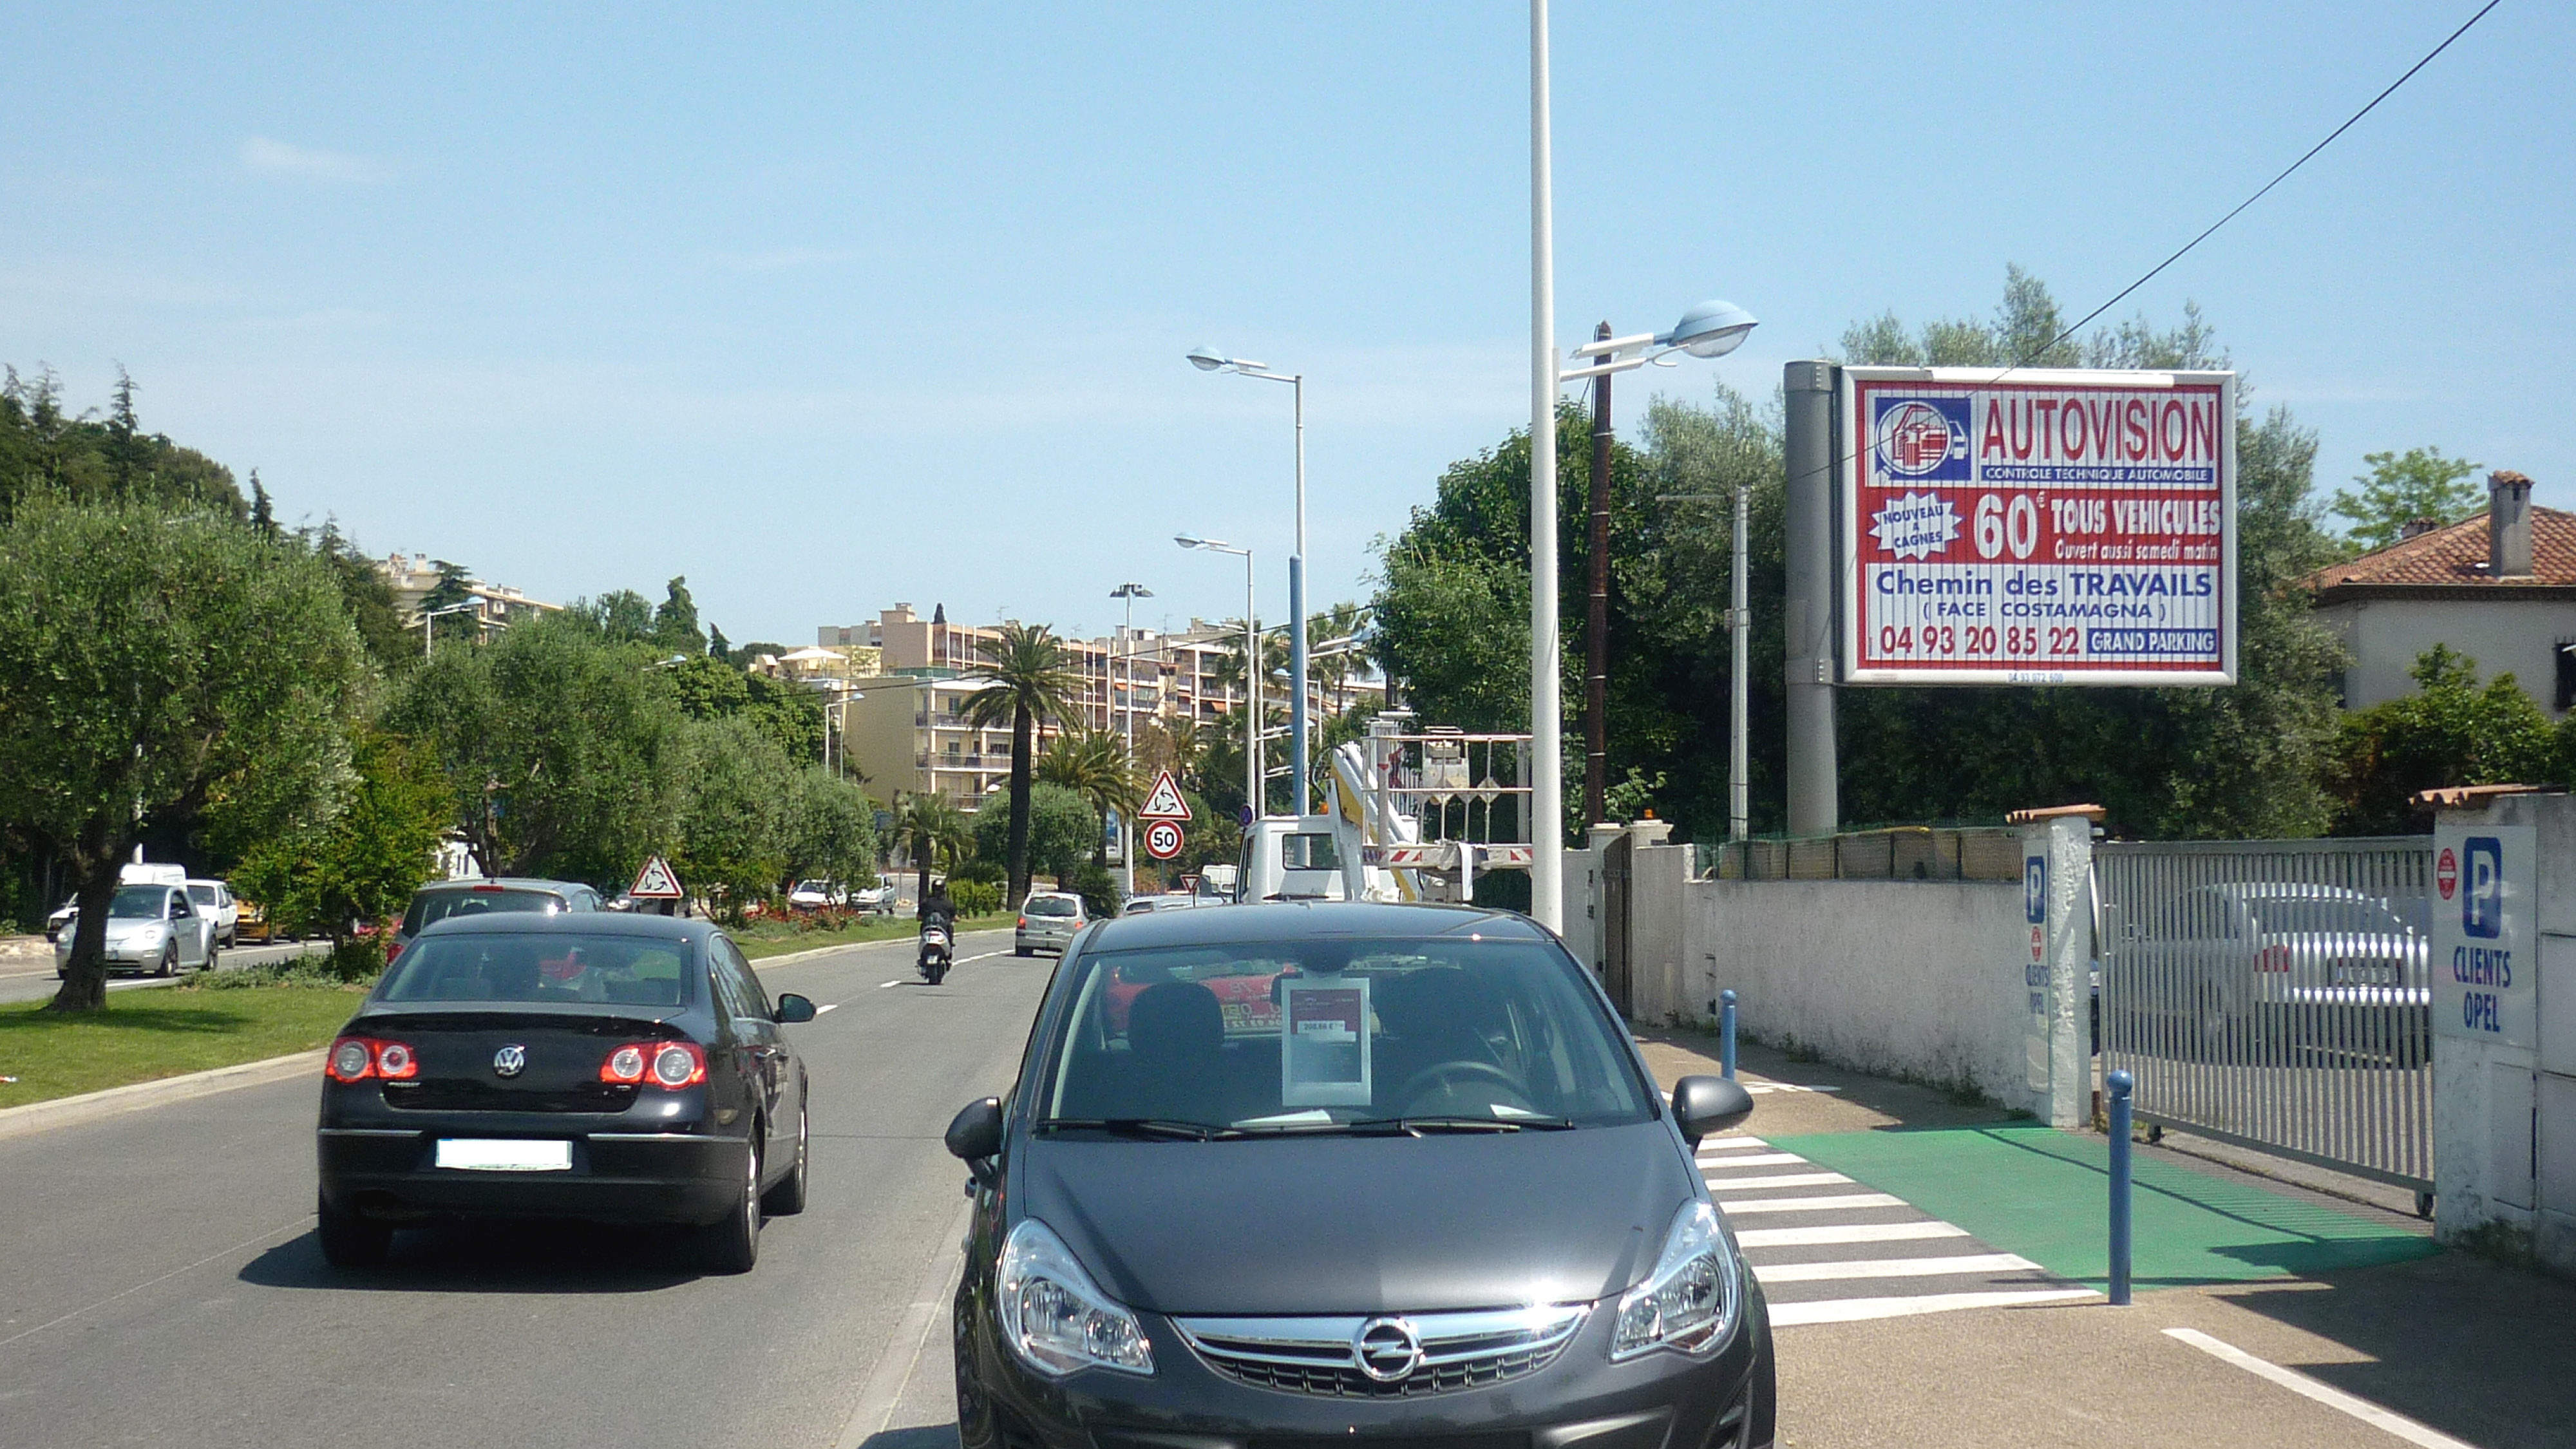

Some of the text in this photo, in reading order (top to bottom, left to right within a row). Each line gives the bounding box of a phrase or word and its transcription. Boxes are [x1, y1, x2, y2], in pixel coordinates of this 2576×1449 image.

[1981, 398, 2214, 462] AUTOVISION
[1985, 467, 2208, 481] CONTROLE TECHNIQUE AUTOMOBILE
[1882, 504, 1944, 525] NOUVEAU
[2050, 498, 2107, 535] TOUS
[2112, 499, 2221, 535] VEHICULES
[1893, 531, 1943, 548] CAGNES
[2054, 538, 2217, 561] Ouvert aussi samedi matin
[1876, 569, 2212, 597] Chemin des TRAVAILS
[2000, 603, 2152, 618] COSTAMAGNA
[1880, 625, 1913, 654] 04
[1922, 625, 1956, 655] 93
[1965, 625, 1997, 655] 20
[2006, 626, 2038, 656] 85
[2047, 627, 2080, 656] 22
[2091, 631, 2215, 652] GRAND PARKING
[1153, 831, 1175, 847] 50
[2030, 864, 2042, 916] P
[2471, 849, 2496, 926] P
[2454, 945, 2511, 988] CLIENTS
[2463, 991, 2501, 1033] OPEL
